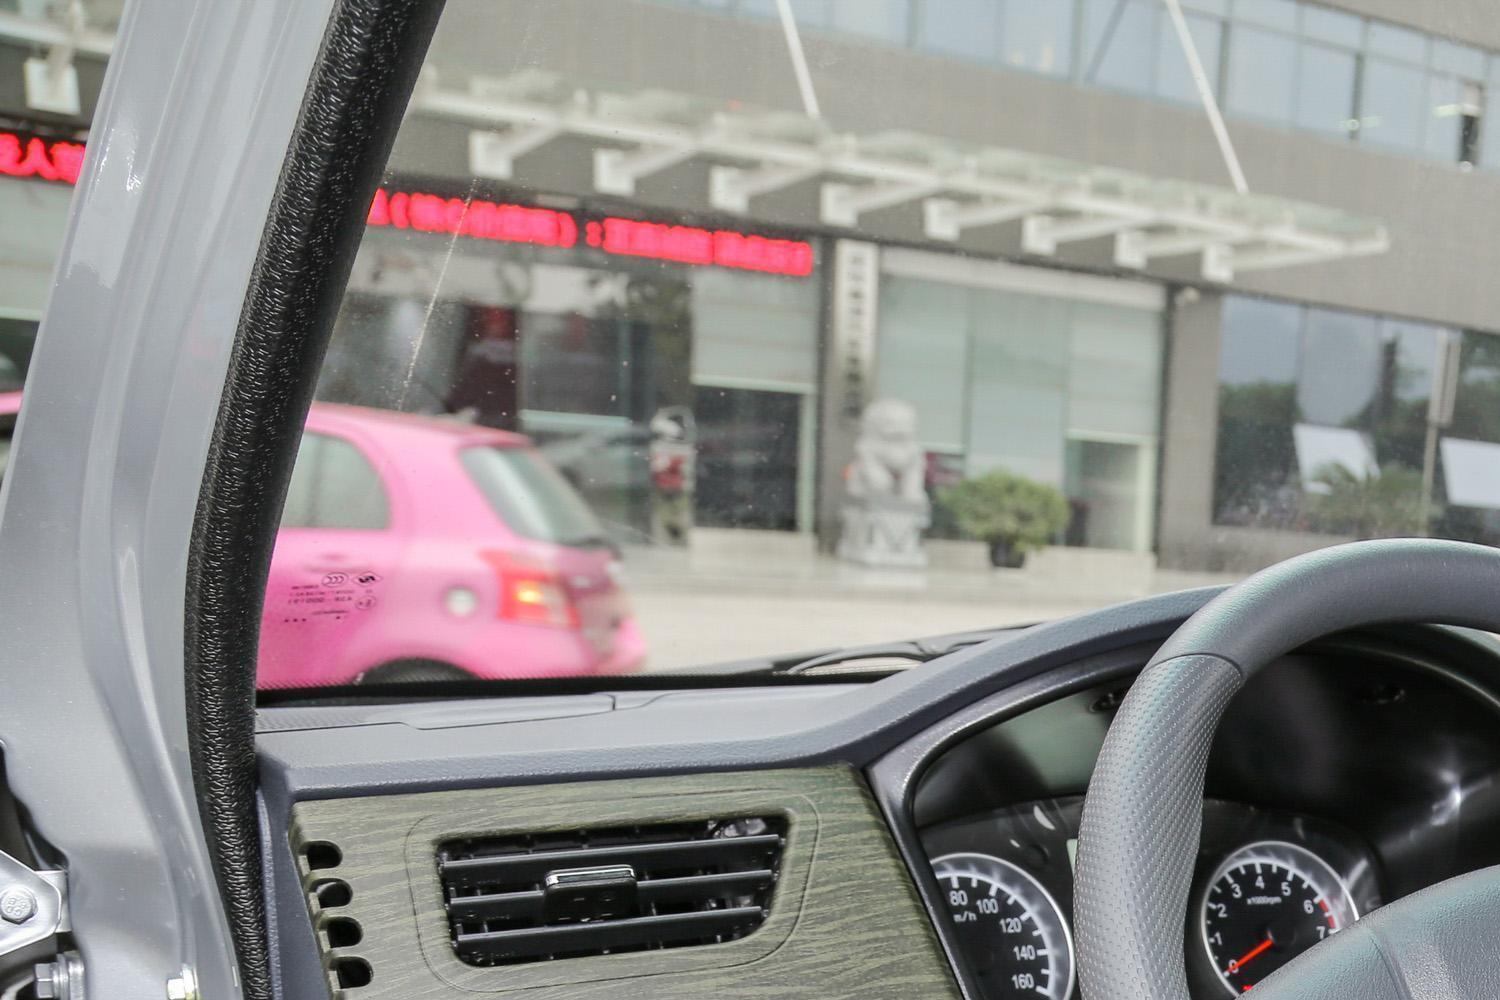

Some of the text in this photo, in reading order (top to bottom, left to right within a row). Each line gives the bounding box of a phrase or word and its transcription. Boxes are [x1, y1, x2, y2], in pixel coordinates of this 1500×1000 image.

[1255, 875, 1265, 889] 4
[1281, 881, 1291, 896] 5
[949, 890, 968, 905] 80
[1231, 883, 1242, 899] 3
[976, 898, 999, 914] 100
[1218, 903, 1228, 918] 2
[1303, 900, 1314, 914] 6
[999, 917, 1022, 933] 120
[1316, 926, 1325, 939] 7
[1214, 932, 1222, 946] 1
[1013, 944, 1036, 960] 140
[1011, 973, 1035, 989] 160
